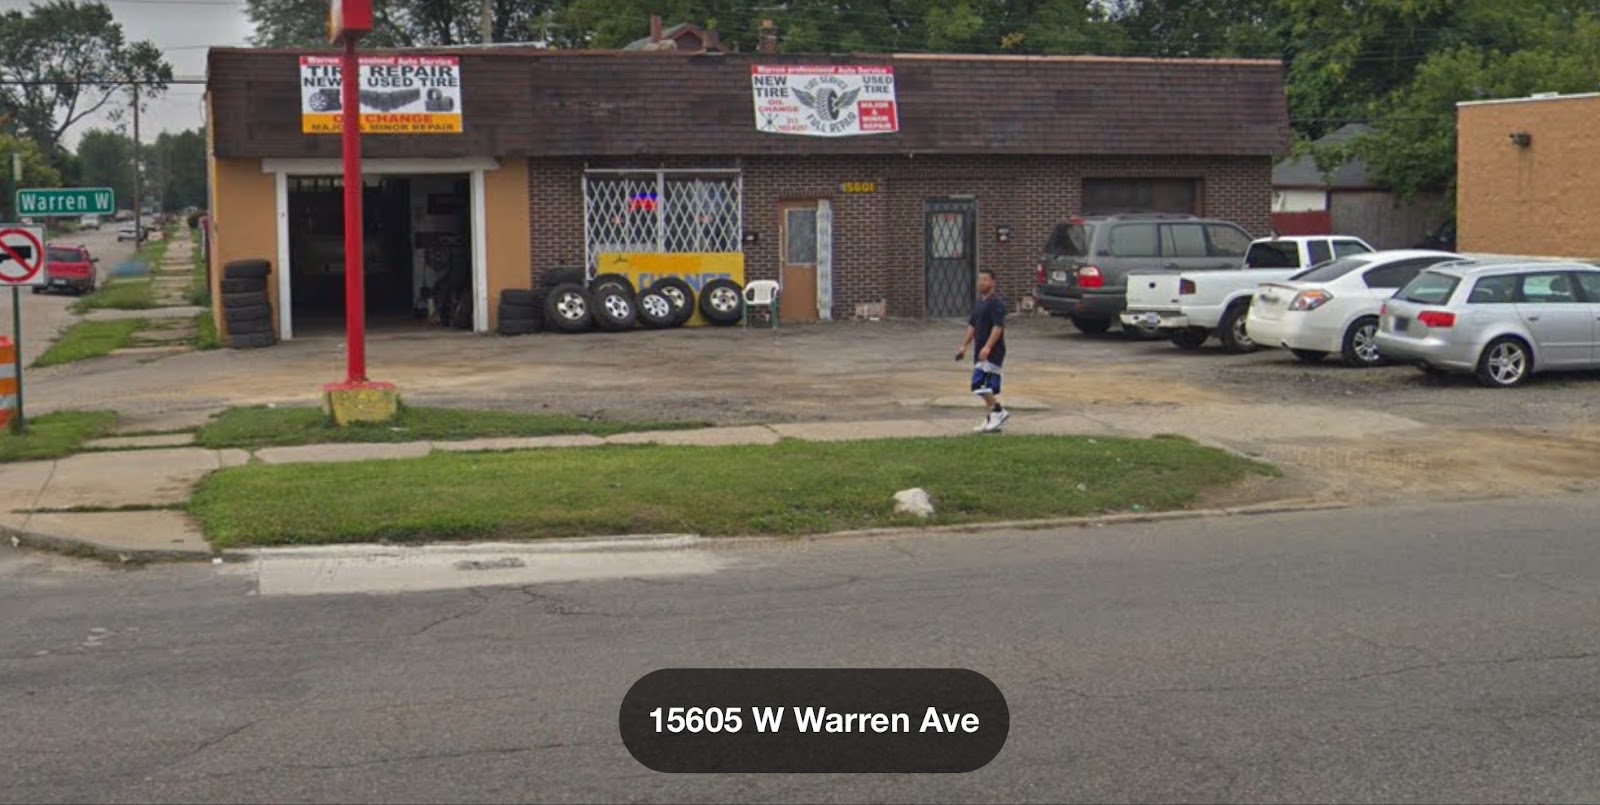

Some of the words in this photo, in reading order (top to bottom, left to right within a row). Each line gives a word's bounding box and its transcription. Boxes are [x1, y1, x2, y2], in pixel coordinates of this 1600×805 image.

[307, 57, 340, 65] Warren
[358, 57, 395, 65] essional
[398, 57, 418, 65] Auto
[420, 57, 453, 65] Service
[306, 65, 343, 77] TIR
[370, 65, 453, 77] REPAIR
[757, 66, 785, 74] Warren
[838, 66, 856, 74] Auto
[857, 66, 887, 74] Service
[304, 77, 342, 88] NEW
[367, 77, 413, 88] USED
[419, 77, 459, 88] TIRE
[754, 76, 787, 86] NEW
[862, 76, 892, 85] USED
[754, 87, 789, 98] TIRE
[864, 85, 890, 94] TIRE
[366, 114, 433, 124] CHANGE
[805, 113, 827, 132] FULL
[829, 111, 857, 133] REPAIR
[862, 122, 893, 130] REPAIR
[21, 193, 88, 212] Warren
[95, 192, 110, 210] W
